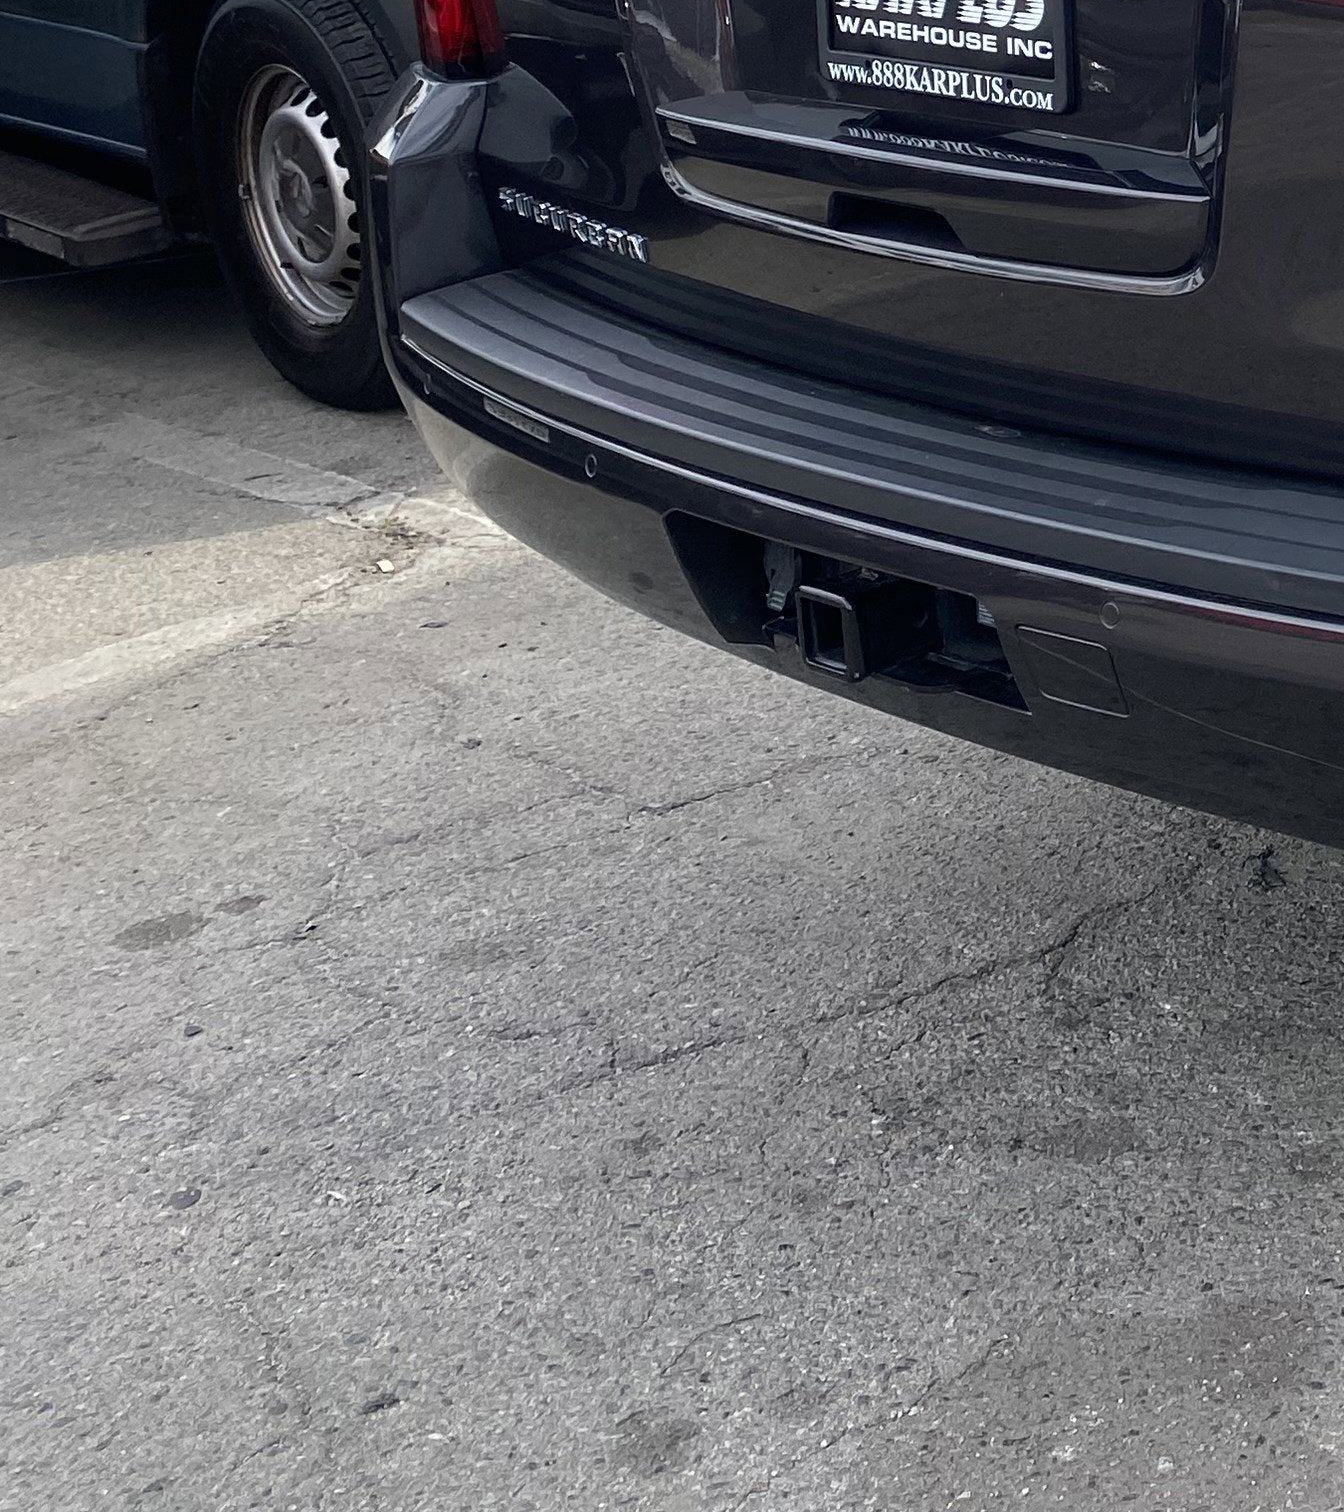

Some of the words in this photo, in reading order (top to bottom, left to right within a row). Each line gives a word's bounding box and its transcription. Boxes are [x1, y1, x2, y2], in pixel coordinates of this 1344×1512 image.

[835, 14, 998, 53] WAREHOUSE
[1006, 36, 1053, 60] INC
[499, 187, 648, 263] SUBURBAN
